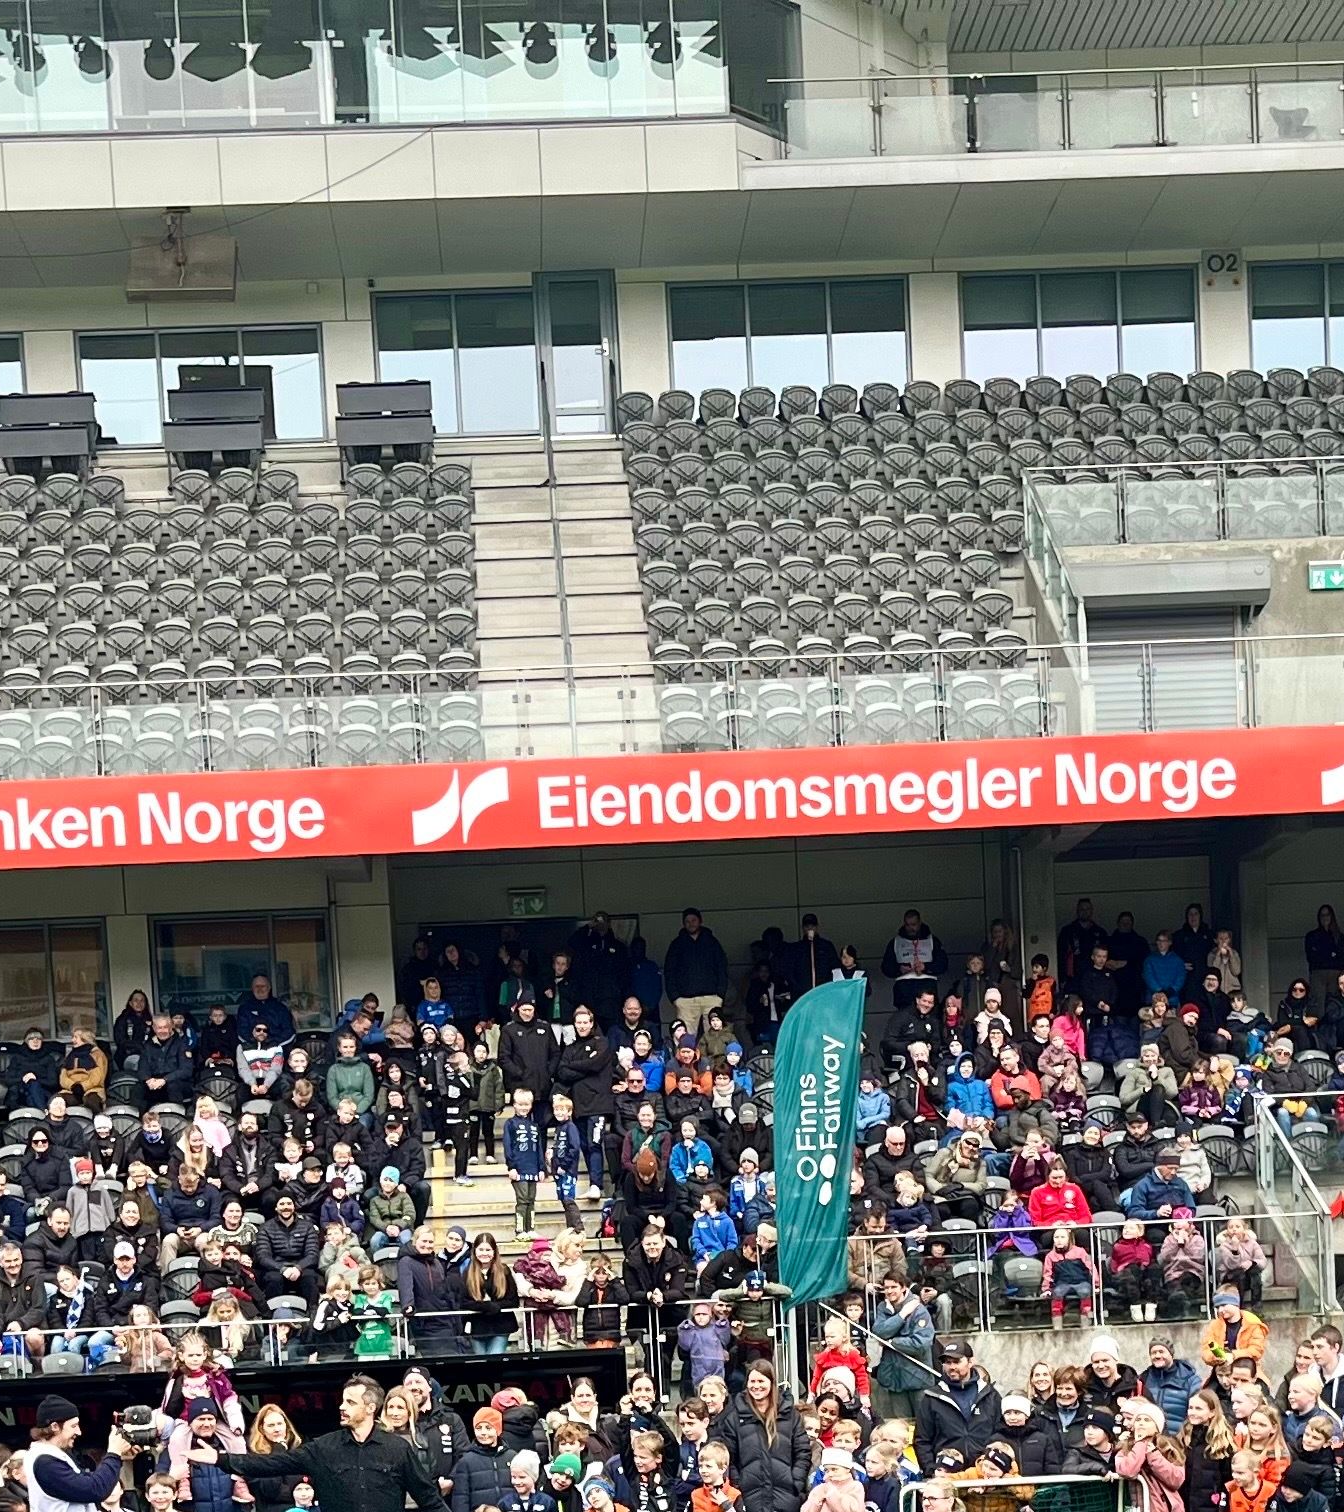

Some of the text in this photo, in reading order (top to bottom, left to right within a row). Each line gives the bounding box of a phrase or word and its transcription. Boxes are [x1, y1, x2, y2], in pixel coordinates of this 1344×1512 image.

[138, 791, 325, 853] Norge
[538, 752, 1237, 829] Eiendomsmegler Norge
[796, 1073, 817, 1151] Finns
[819, 1034, 845, 1150] Fairway
